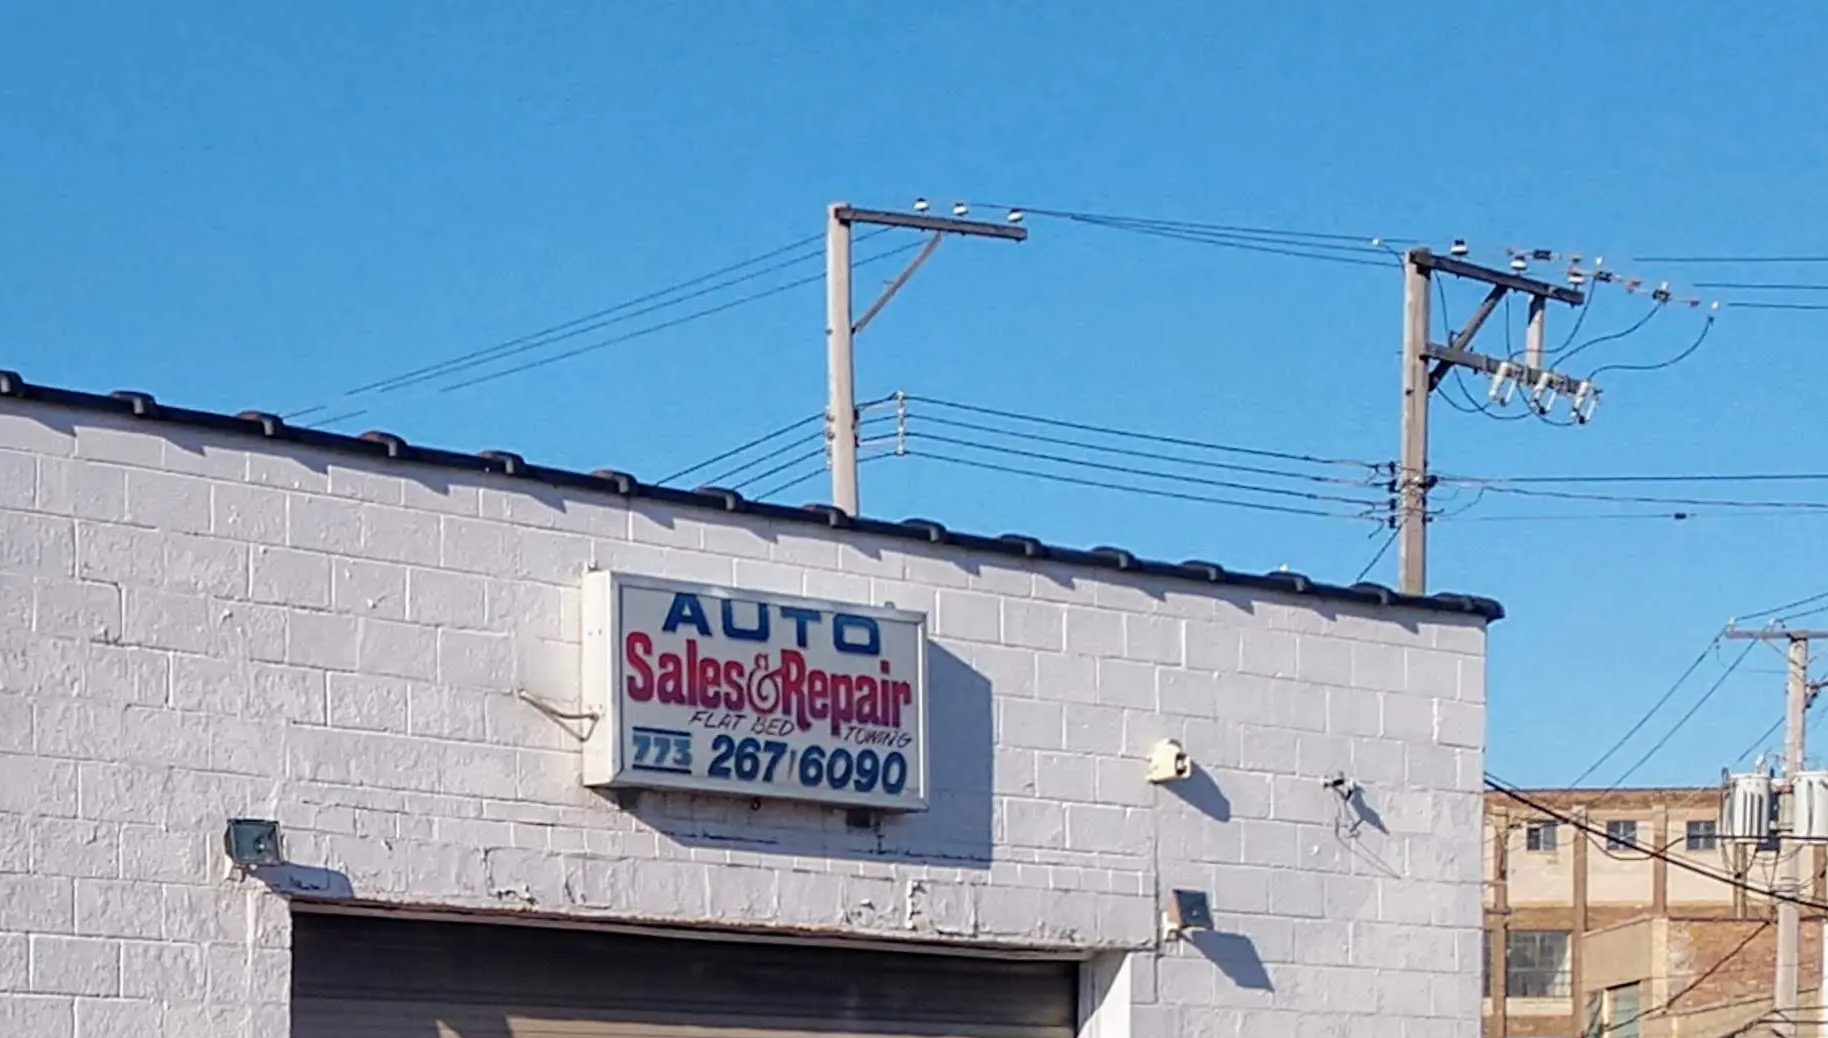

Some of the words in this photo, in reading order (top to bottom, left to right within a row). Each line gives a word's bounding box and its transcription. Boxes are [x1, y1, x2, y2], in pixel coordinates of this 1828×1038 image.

[662, 592, 881, 656] AUTO
[626, 631, 745, 712] Sales
[780, 648, 912, 737] Repair
[688, 710, 747, 729] FLAT
[750, 715, 795, 736] BED
[843, 725, 913, 748] TOWING
[632, 734, 693, 766] 773
[799, 745, 907, 795] 6090
